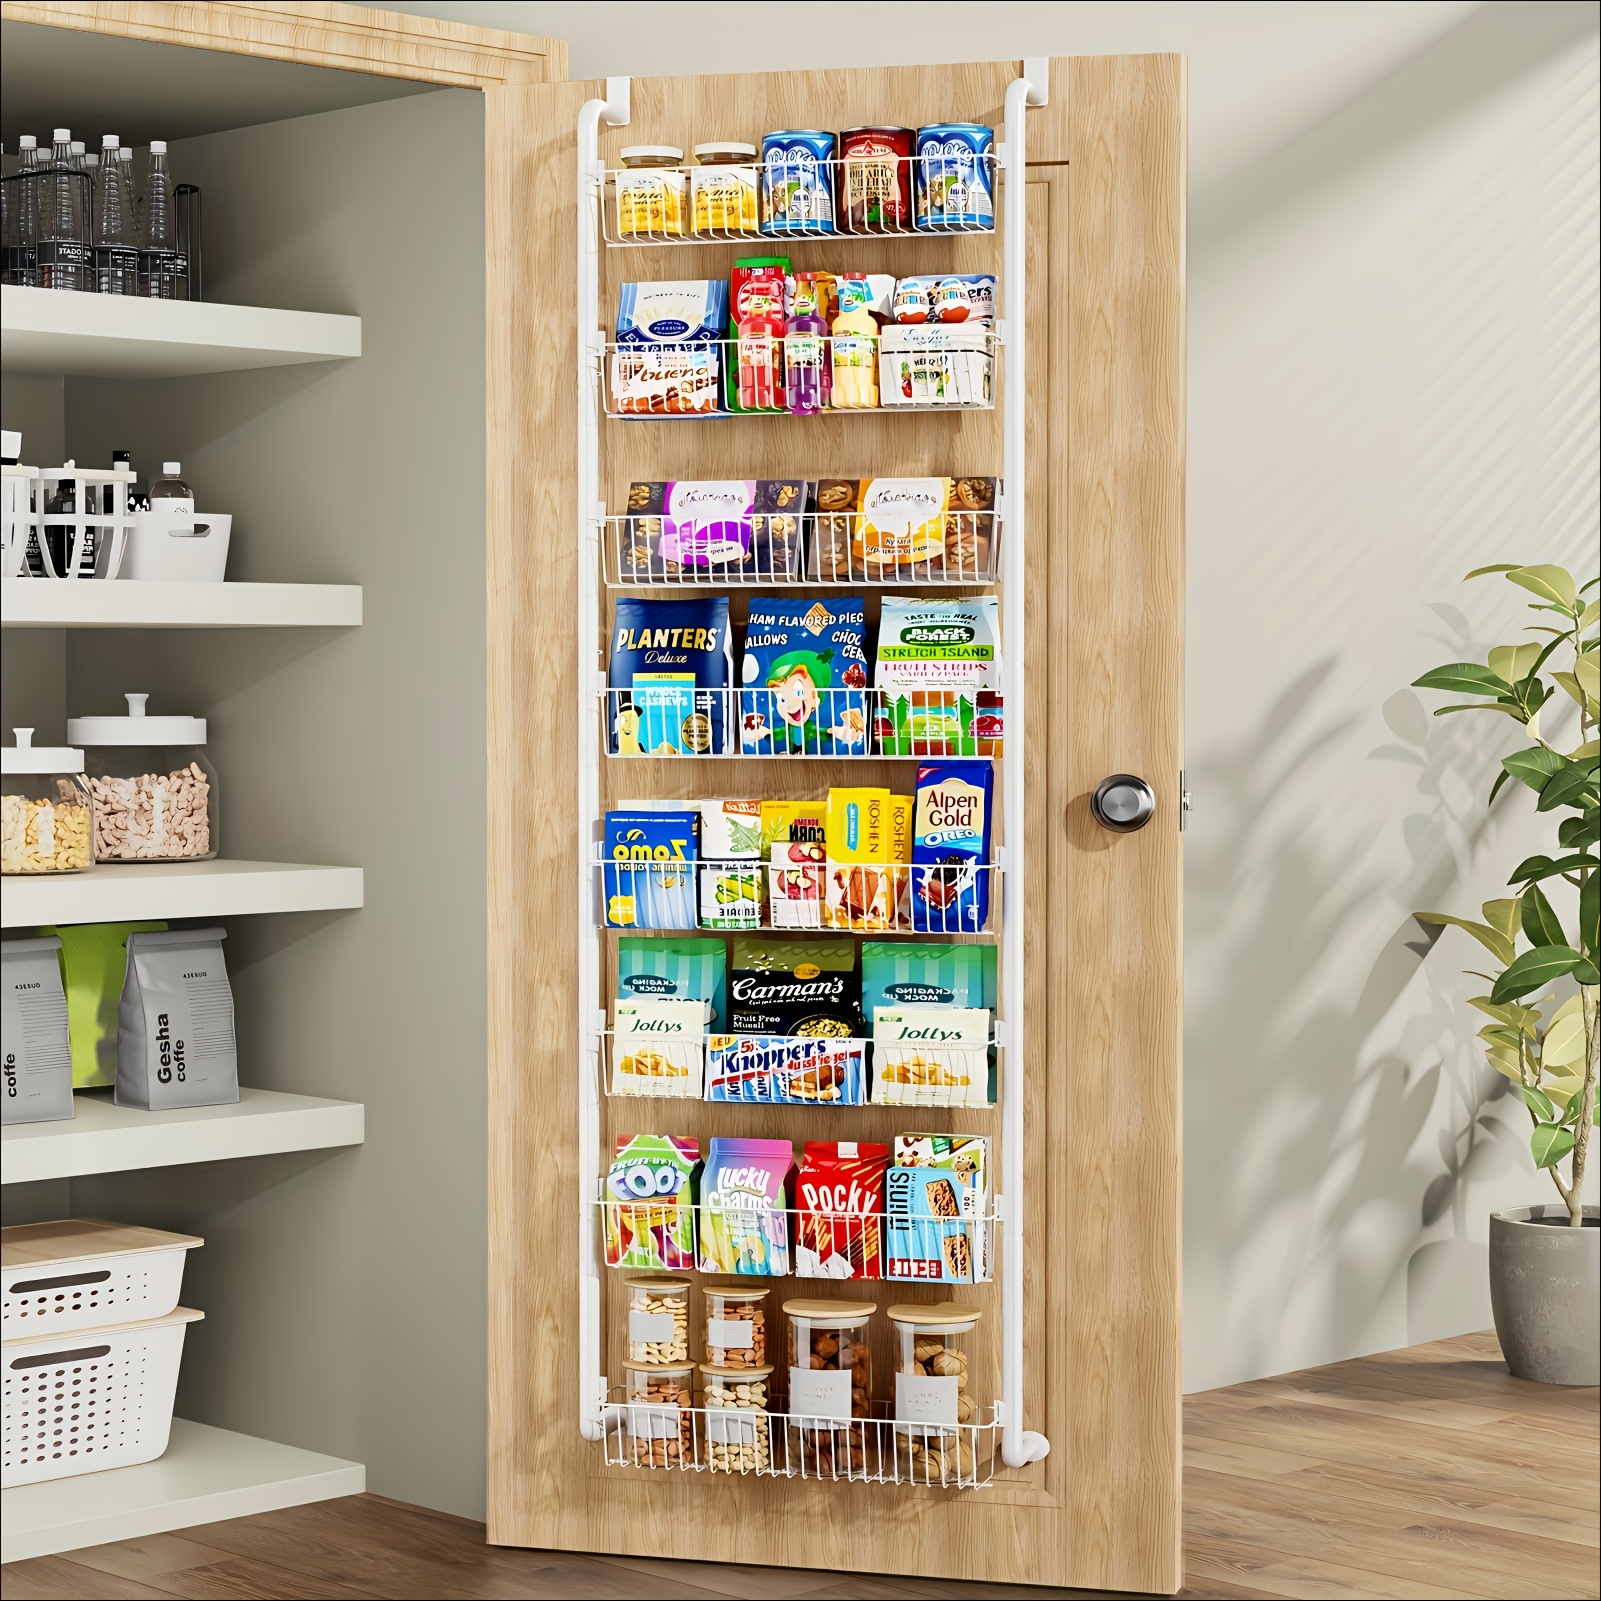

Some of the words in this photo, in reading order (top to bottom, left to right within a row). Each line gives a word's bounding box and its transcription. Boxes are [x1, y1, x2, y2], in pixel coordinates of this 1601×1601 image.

[778, 614, 837, 627] FLAVORED
[616, 628, 718, 653] PLANTERS
[644, 651, 688, 664] Deluxe
[926, 790, 977, 813] Alpen
[868, 799, 880, 853] ROSHEN
[928, 808, 972, 827] Gold
[893, 806, 905, 860] ROSHEN
[923, 829, 976, 848] OREO
[732, 977, 844, 1000] Carman's
[630, 1018, 682, 1033] Jollys
[897, 1026, 963, 1041] Jollys
[155, 1013, 173, 1084] Gesha
[714, 1037, 731, 1047] EU
[173, 1039, 186, 1082] coffe
[3, 1053, 17, 1098] coffe
